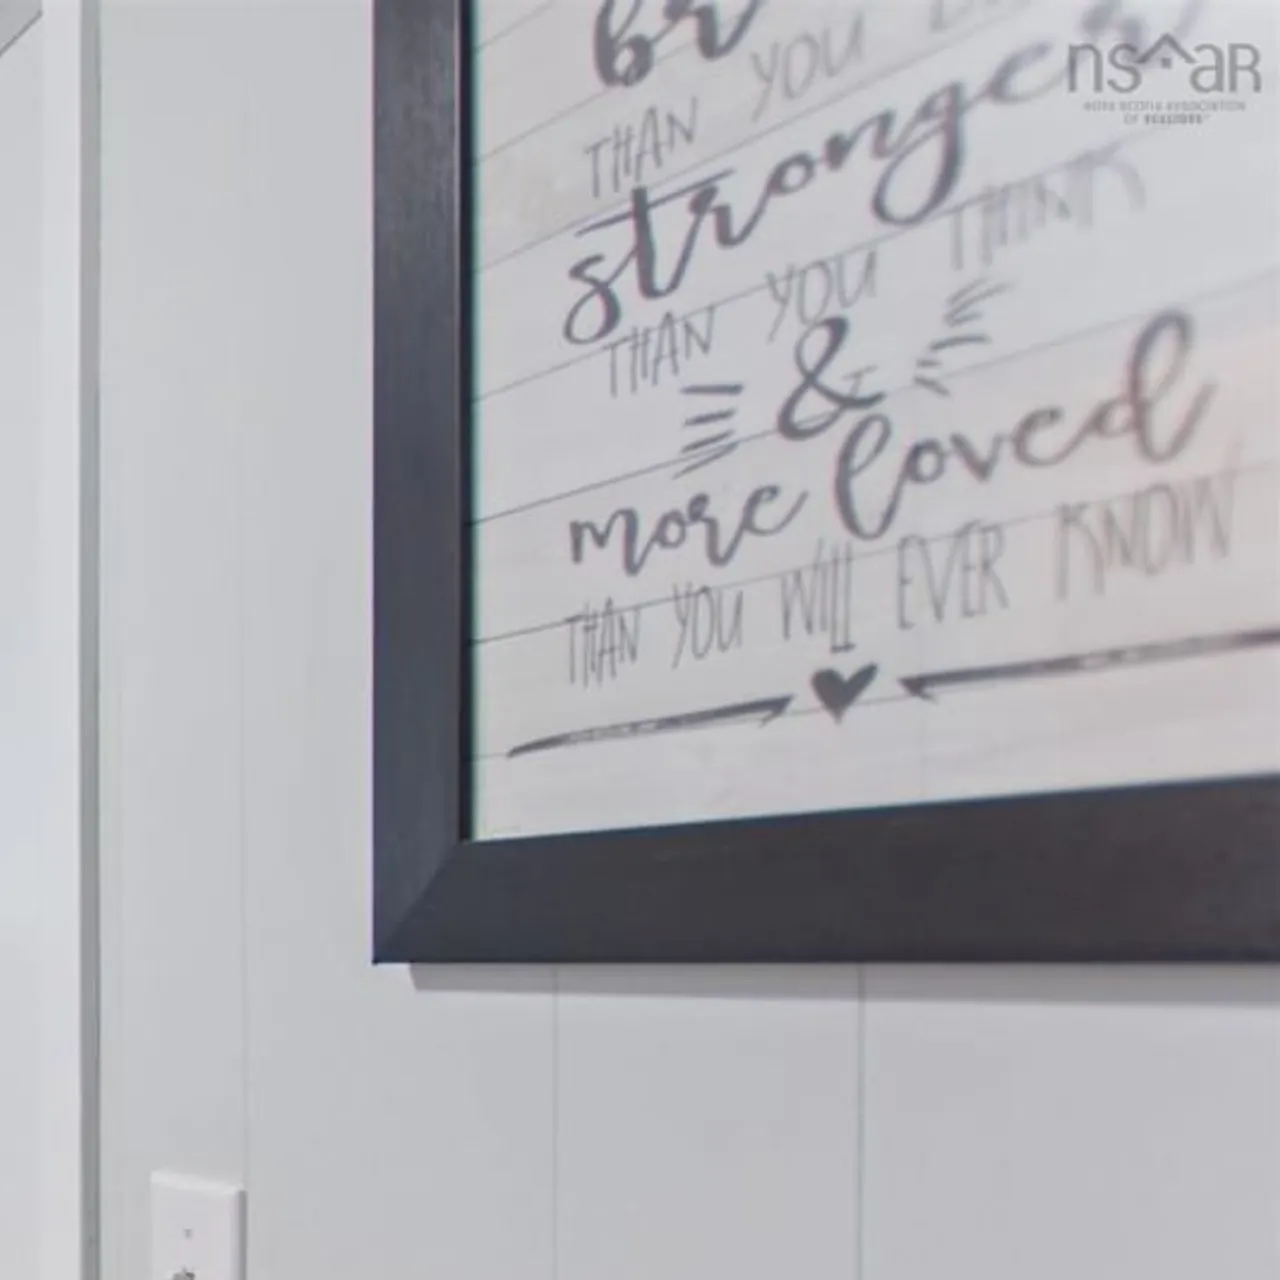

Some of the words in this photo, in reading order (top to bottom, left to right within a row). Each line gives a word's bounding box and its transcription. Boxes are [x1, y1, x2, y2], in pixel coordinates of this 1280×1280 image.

[583, 97, 700, 199] THAN
[748, 15, 867, 121] YOU
[602, 305, 716, 399] THAN
[765, 250, 878, 345] YOU
[776, 315, 886, 442] &
[567, 488, 810, 577] more
[834, 310, 1219, 540] loved
[561, 595, 641, 689] THAN
[670, 578, 746, 670] YOU
[778, 537, 860, 655] WILL
[895, 518, 1012, 632] EVER
[1052, 472, 1240, 602] KNOW
